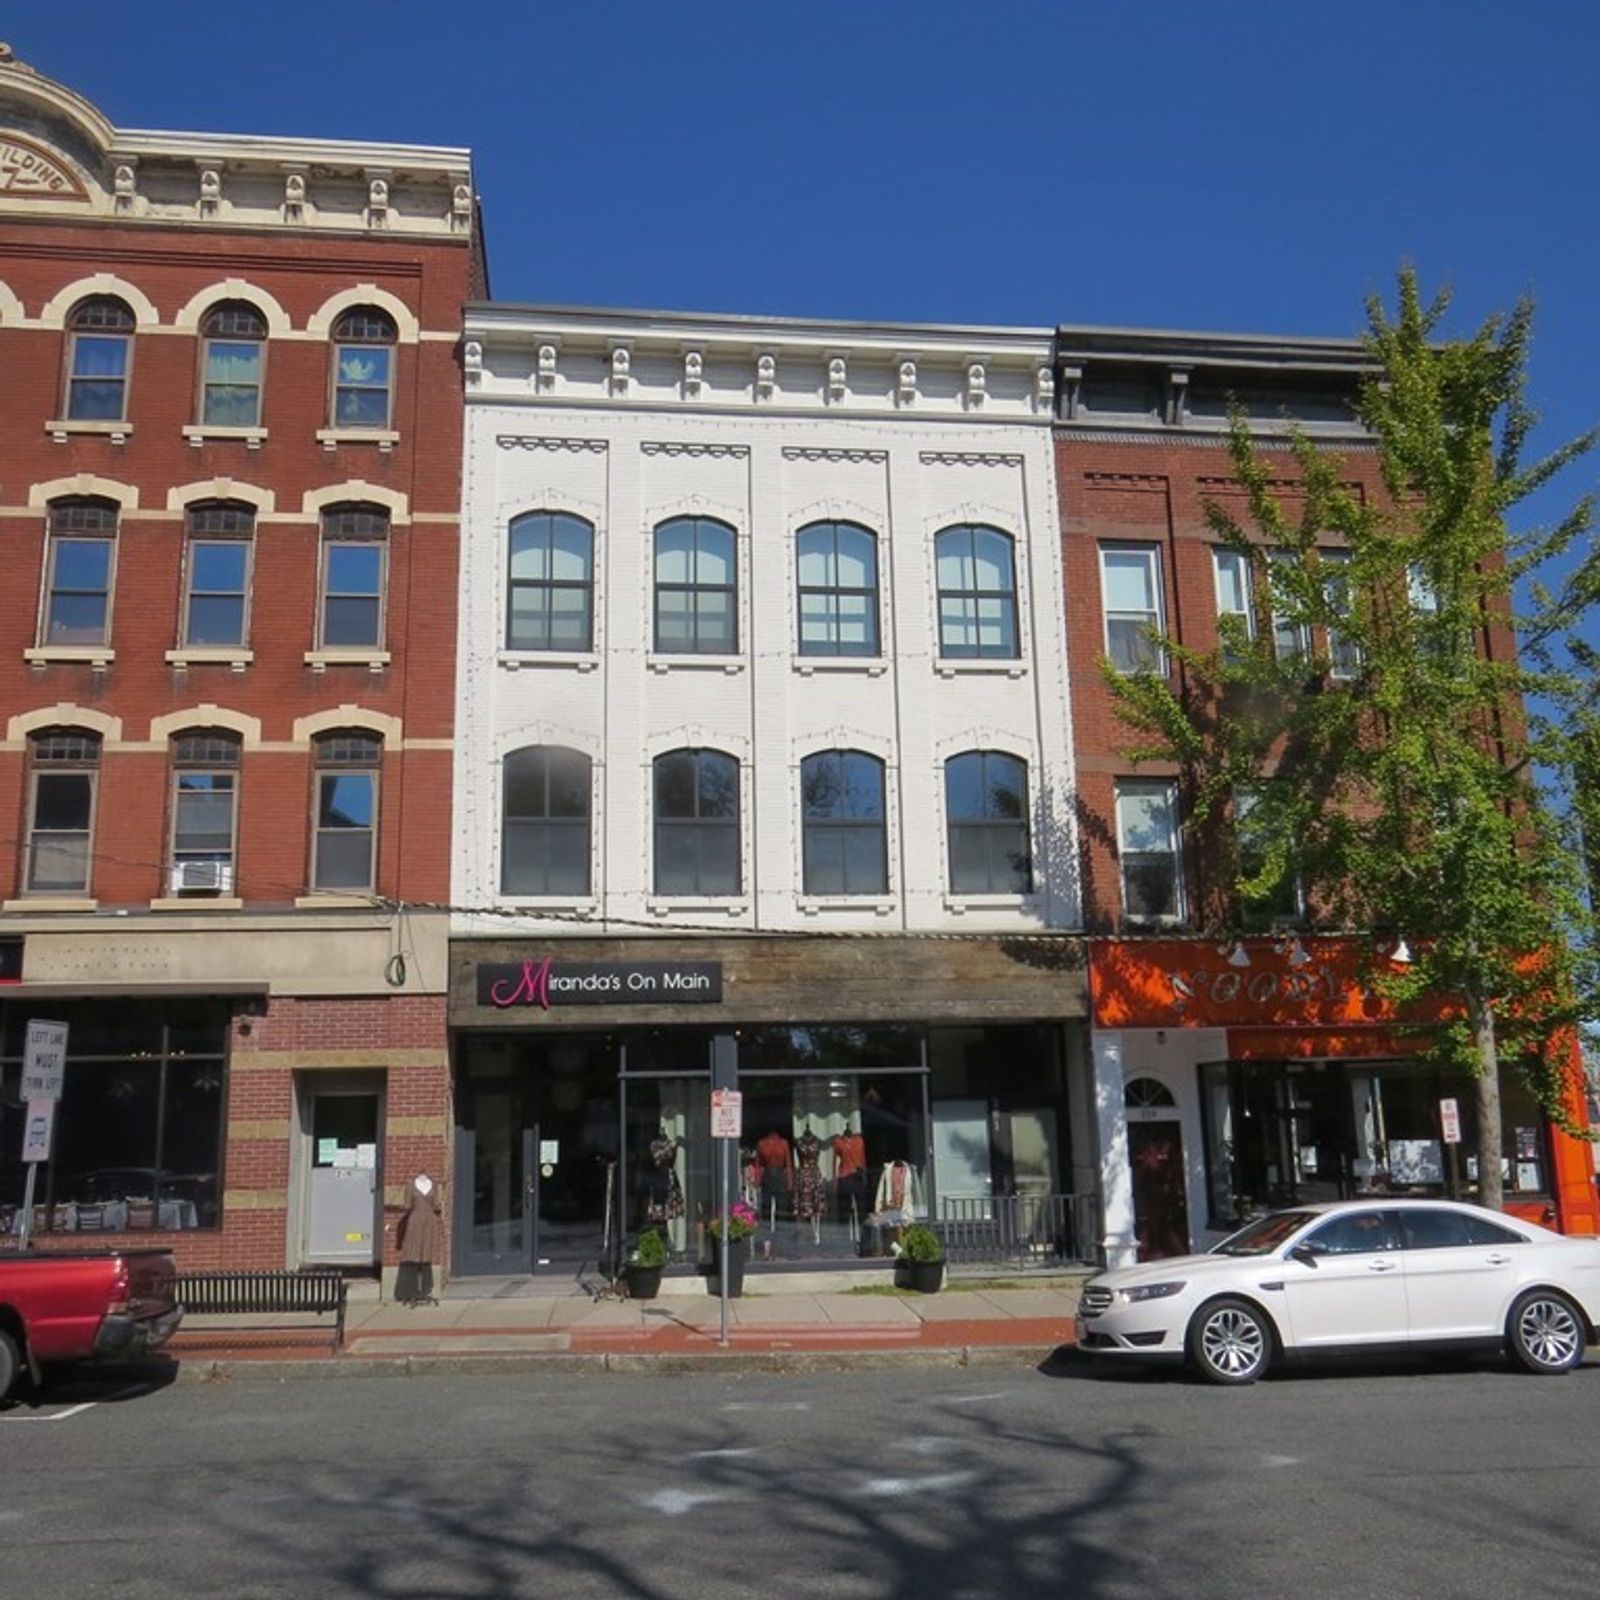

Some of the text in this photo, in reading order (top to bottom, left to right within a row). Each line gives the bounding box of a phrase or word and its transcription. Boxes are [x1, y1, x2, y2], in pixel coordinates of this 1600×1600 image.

[0, 146, 64, 191] ILDING
[491, 954, 709, 1010] Miranda's On Main
[31, 1030, 48, 1044] LEFT
[36, 1053, 58, 1068] MUST
